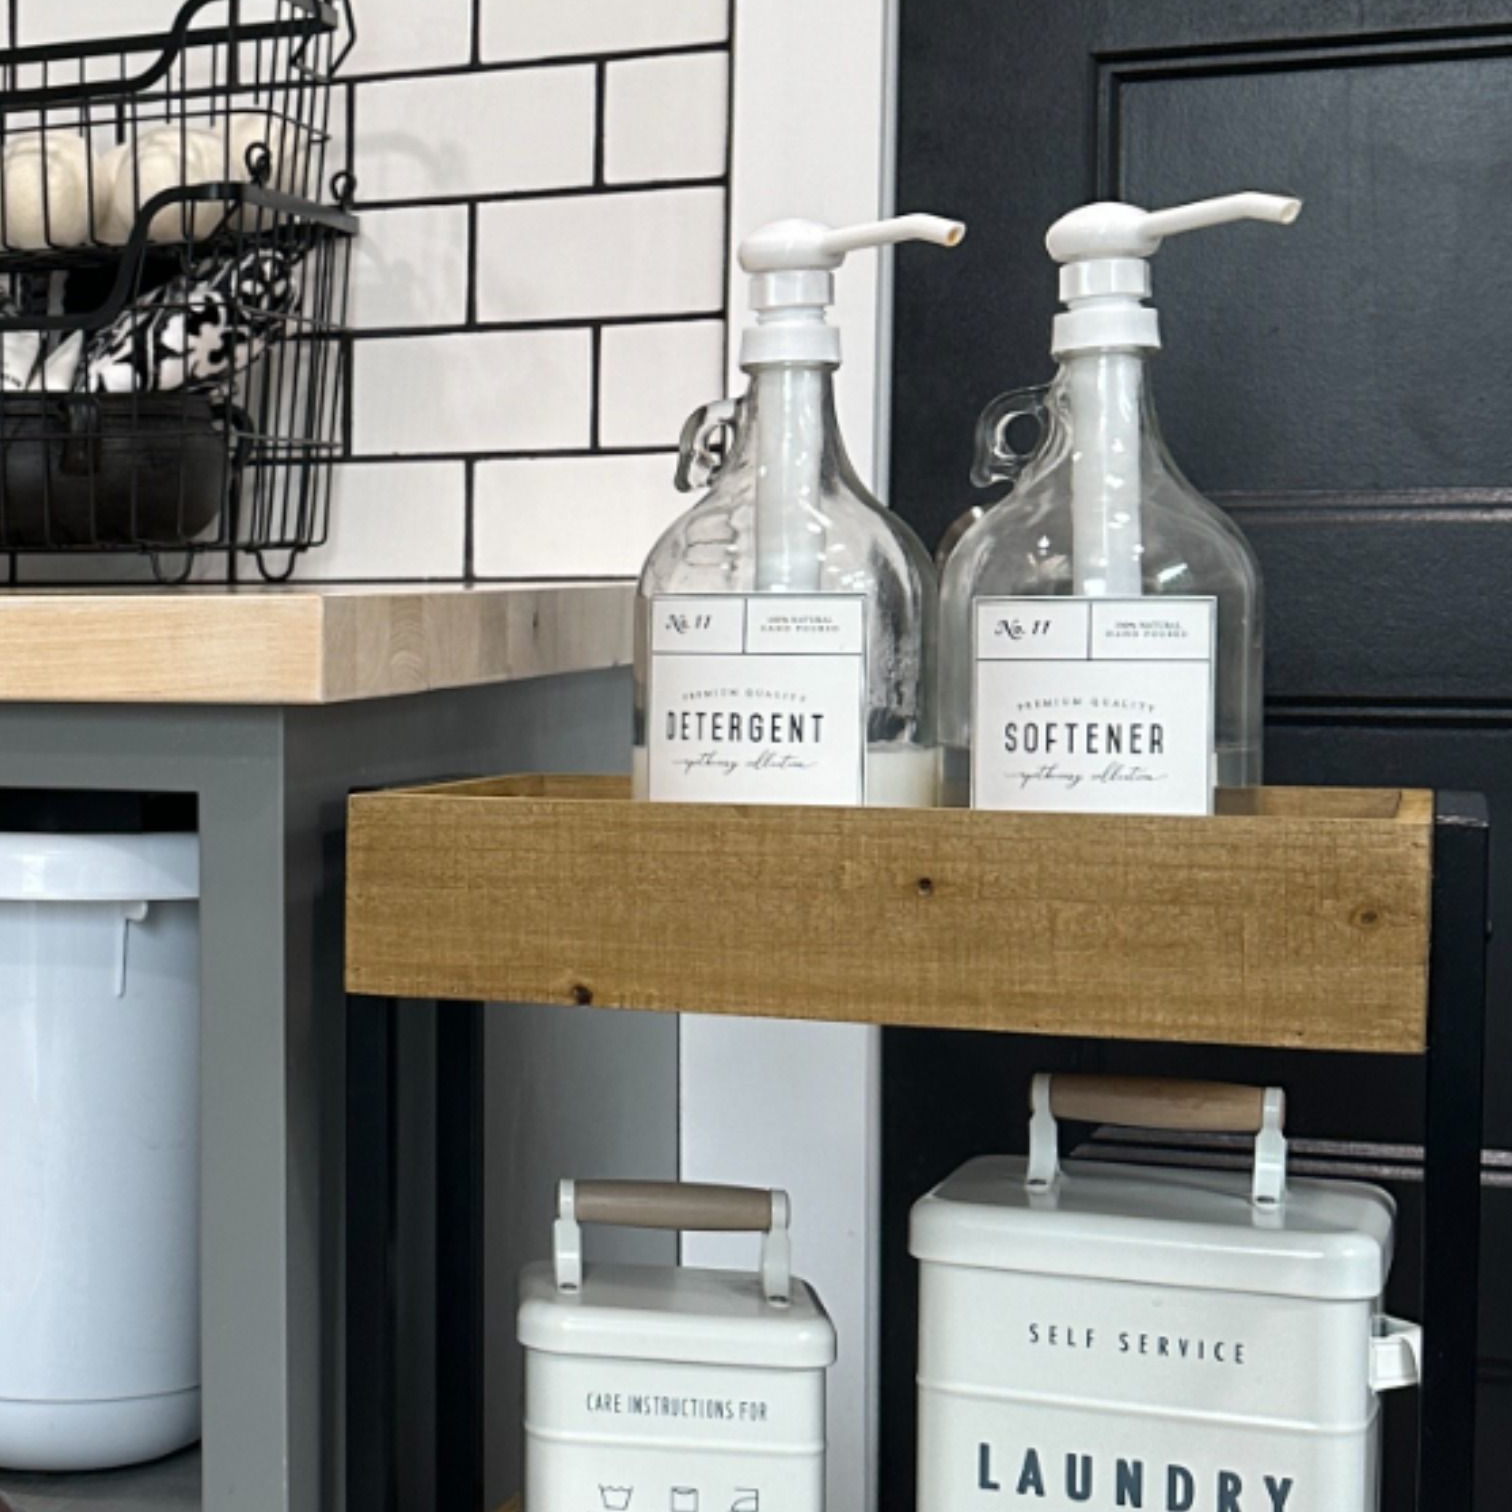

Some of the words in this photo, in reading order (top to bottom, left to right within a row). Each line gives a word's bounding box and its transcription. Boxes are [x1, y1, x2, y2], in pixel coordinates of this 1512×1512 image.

[682, 688, 738, 701] PREMIUM
[745, 688, 806, 703] QUALITY
[1017, 697, 1083, 711] PREMIUM
[1090, 697, 1155, 713] QUALITY
[666, 710, 824, 744] DETERGENT
[1004, 721, 1164, 755] SOFTENER
[1028, 1323, 1096, 1348] SELF
[1118, 1332, 1246, 1365] SERVICE
[586, 1392, 622, 1414] CARE
[627, 1394, 735, 1421] INSTRUCTIONS
[739, 1400, 768, 1422] FOR
